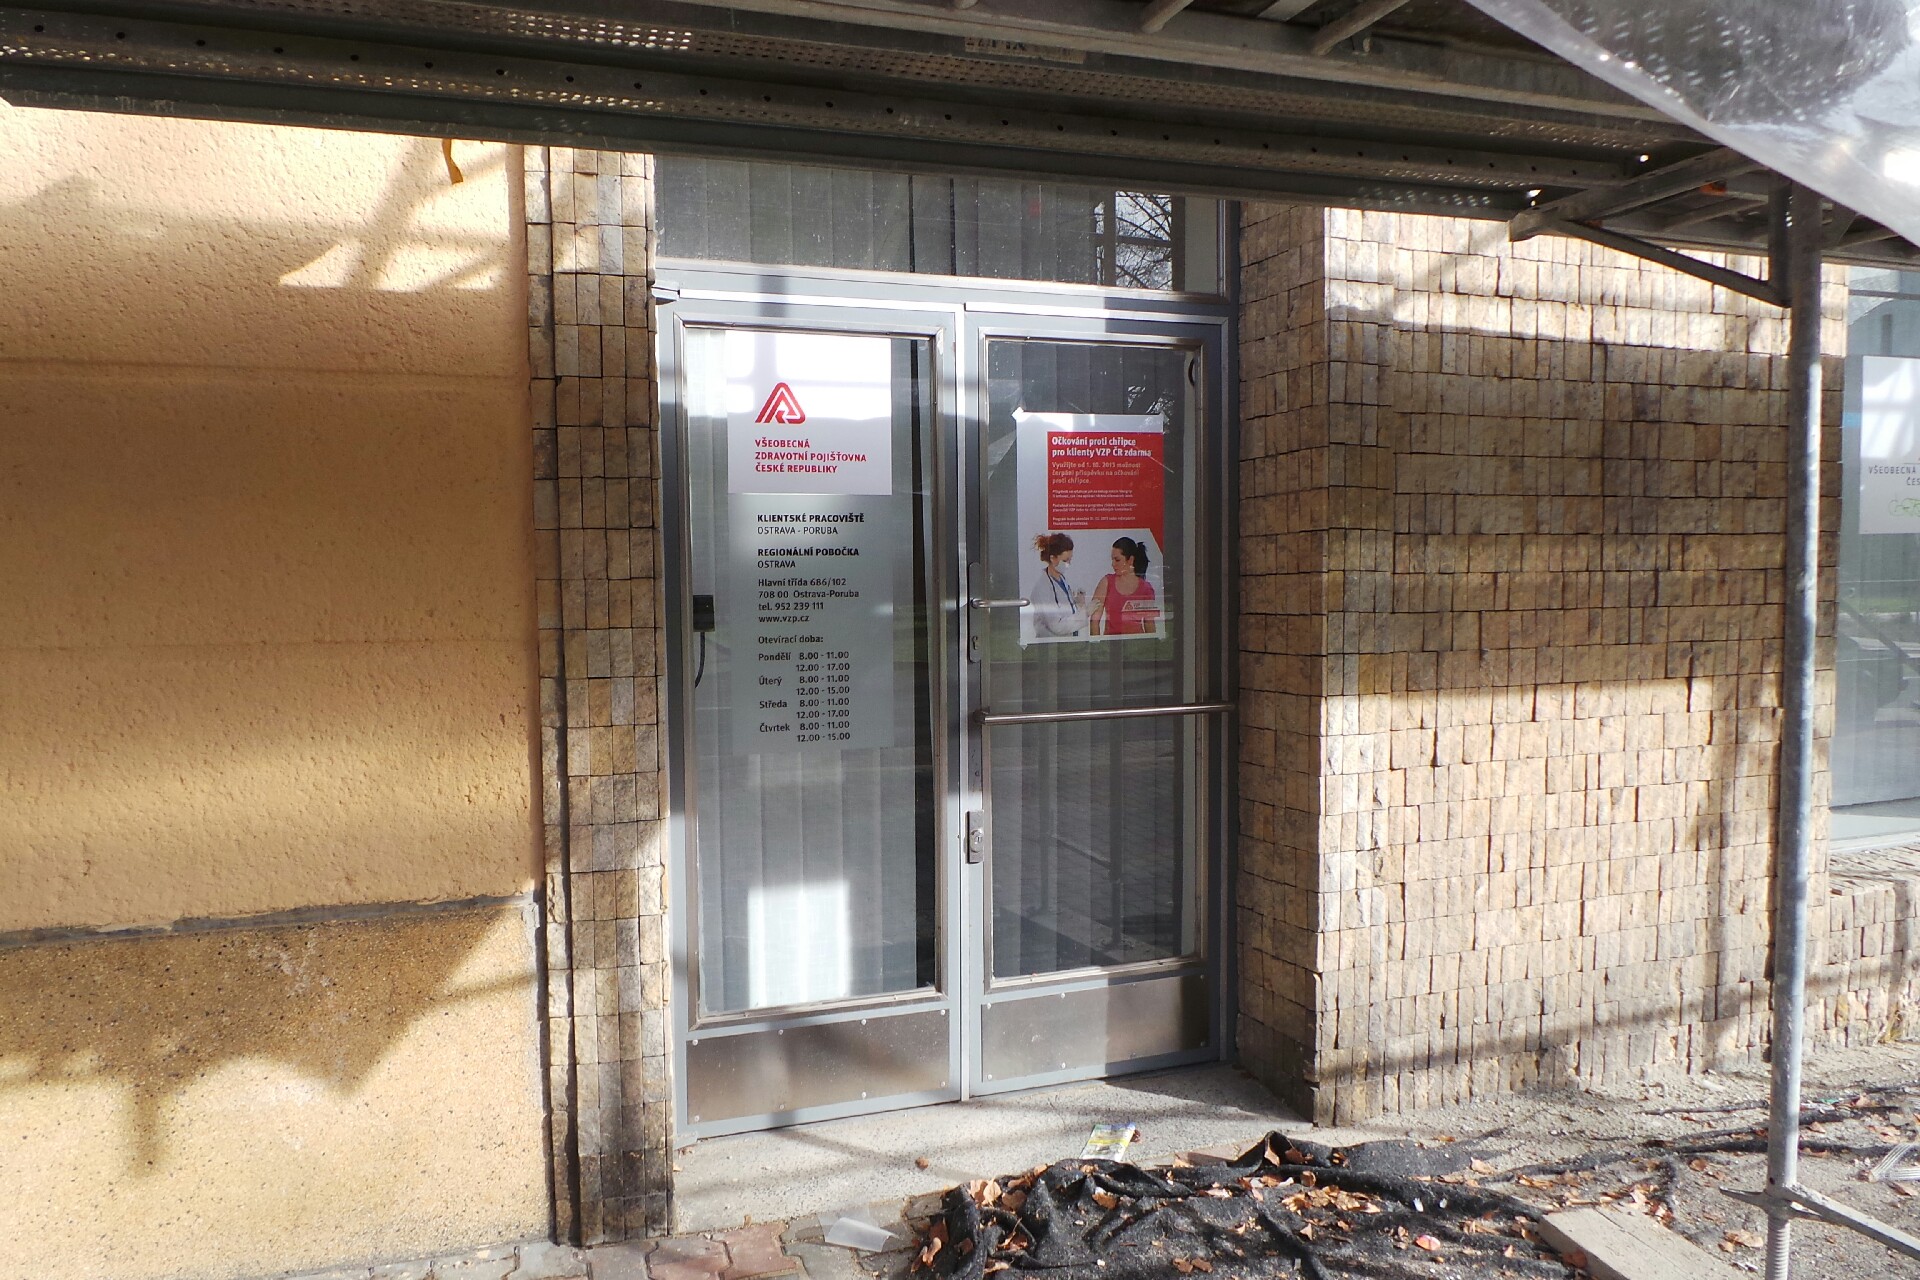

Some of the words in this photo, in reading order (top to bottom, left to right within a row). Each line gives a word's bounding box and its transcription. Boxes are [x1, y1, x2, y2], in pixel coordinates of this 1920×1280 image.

[755, 437, 810, 448] VŠEOBECNÁ
[1051, 436, 1087, 446] Očkování
[1088, 436, 1107, 447] proti
[1108, 436, 1136, 447] chřipce
[755, 451, 808, 461] ZDRAVOTNÍ
[810, 451, 867, 462] POJIŠŤOVNA
[1052, 449, 1065, 458] pro
[1066, 447, 1095, 458] klienty
[1095, 448, 1111, 457] VZP
[1112, 446, 1123, 457] ČR
[1124, 447, 1152, 457] zdarma
[755, 462, 785, 473] ČESKÉ
[787, 464, 837, 473] REPUBLIKY
[757, 513, 807, 522] KLIENTSKÉ
[809, 512, 865, 523] PRACOVIŠTĚ
[757, 526, 796, 535] OSTRAVA
[803, 526, 838, 535] PORUBA
[757, 547, 813, 556] REGIONÁLNÍ
[815, 546, 860, 556] POBOČKA
[757, 560, 796, 569] OSTRAVA
[758, 578, 786, 587] Hlavní
[787, 577, 808, 586] třída
[810, 577, 847, 587] 686/102
[758, 590, 775, 599] 708
[777, 590, 789, 598] 00
[793, 589, 860, 598] Ostrava-Poruba
[758, 602, 773, 611] tel.
[774, 602, 791, 611] 952
[793, 602, 810, 610] 239
[812, 602, 824, 610] 111
[758, 615, 810, 624] www.vzp.cz
[758, 635, 797, 644] Otevírací
[799, 634, 824, 643] doba:
[758, 652, 792, 661] Pondělí
[799, 652, 819, 660] 8.00
[826, 651, 850, 659] 11.00
[796, 663, 820, 672] 12.00
[827, 662, 850, 671] 17.00
[759, 675, 782, 686] Úterý
[799, 675, 819, 684] 8.00
[826, 674, 850, 682] 11.00
[796, 687, 820, 695] 12.00
[827, 686, 850, 694] 15.00
[759, 699, 788, 709] Středa
[799, 699, 820, 707] 8.00
[827, 697, 850, 706] 11.00
[796, 710, 820, 719] 12.00
[827, 709, 850, 718] 17.00
[759, 722, 791, 733] Čtvrtek
[799, 722, 820, 731] 8.00
[827, 720, 850, 729] 11.00
[797, 734, 820, 742] 12.00
[827, 732, 851, 741] 15.00
